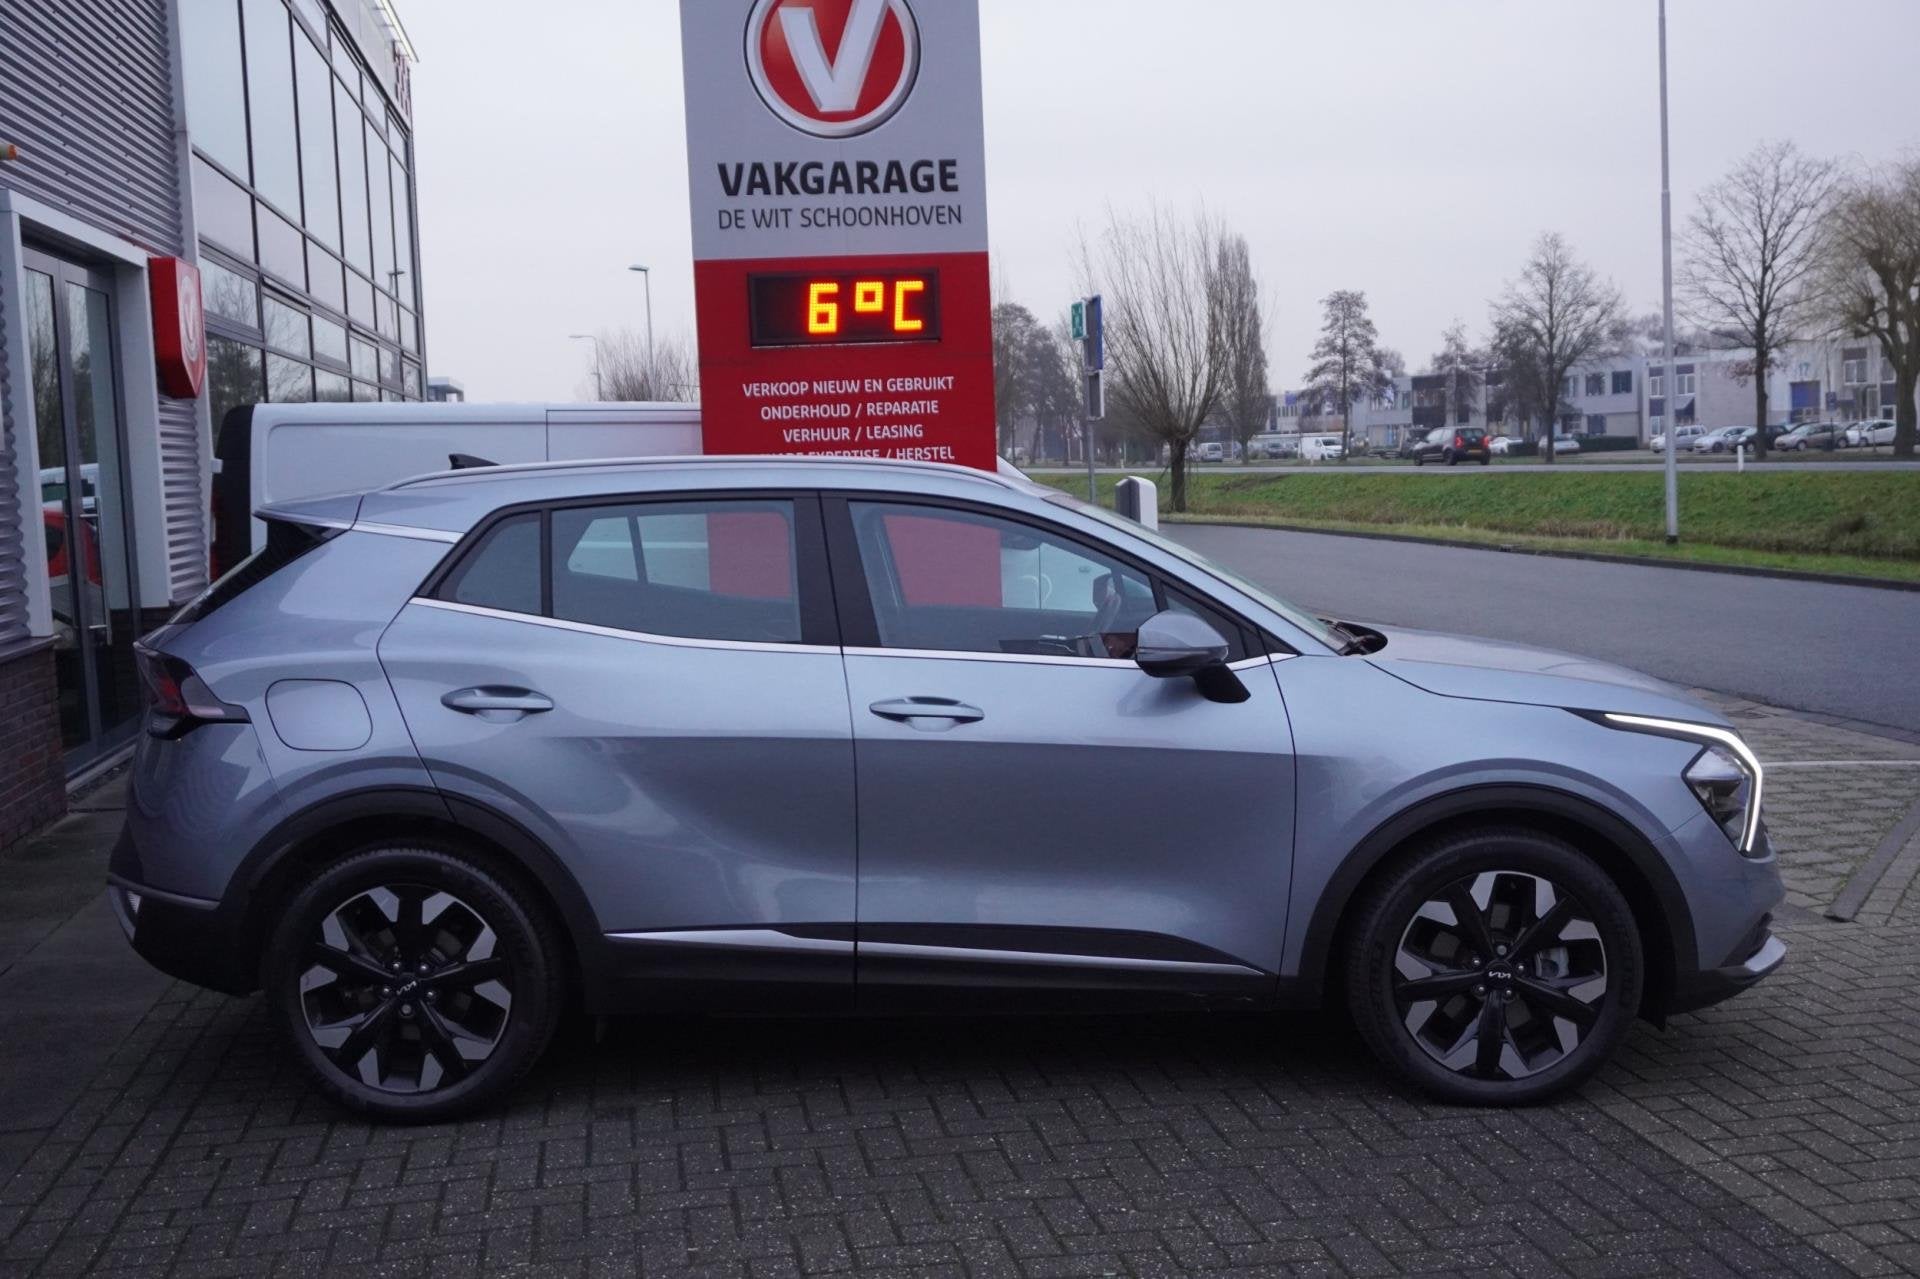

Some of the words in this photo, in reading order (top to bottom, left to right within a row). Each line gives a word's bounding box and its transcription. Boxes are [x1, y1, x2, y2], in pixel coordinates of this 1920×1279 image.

[717, 159, 959, 196] VAKGARAGE
[718, 208, 746, 229] DE
[752, 207, 792, 229] WIT
[800, 204, 962, 228] SCHOONHOVEN
[743, 381, 809, 397] VERKOOP
[813, 379, 860, 395] NIEUW
[865, 378, 883, 392] EN
[887, 376, 954, 392] GEBRUIKT
[761, 403, 850, 420] ONDERHOUD
[855, 402, 863, 418] /
[867, 400, 939, 416] REPARATIE
[783, 427, 850, 442] VERHUUR
[855, 426, 863, 442] /
[867, 424, 923, 440] LEASING
[896, 446, 955, 461] HERSTEL
